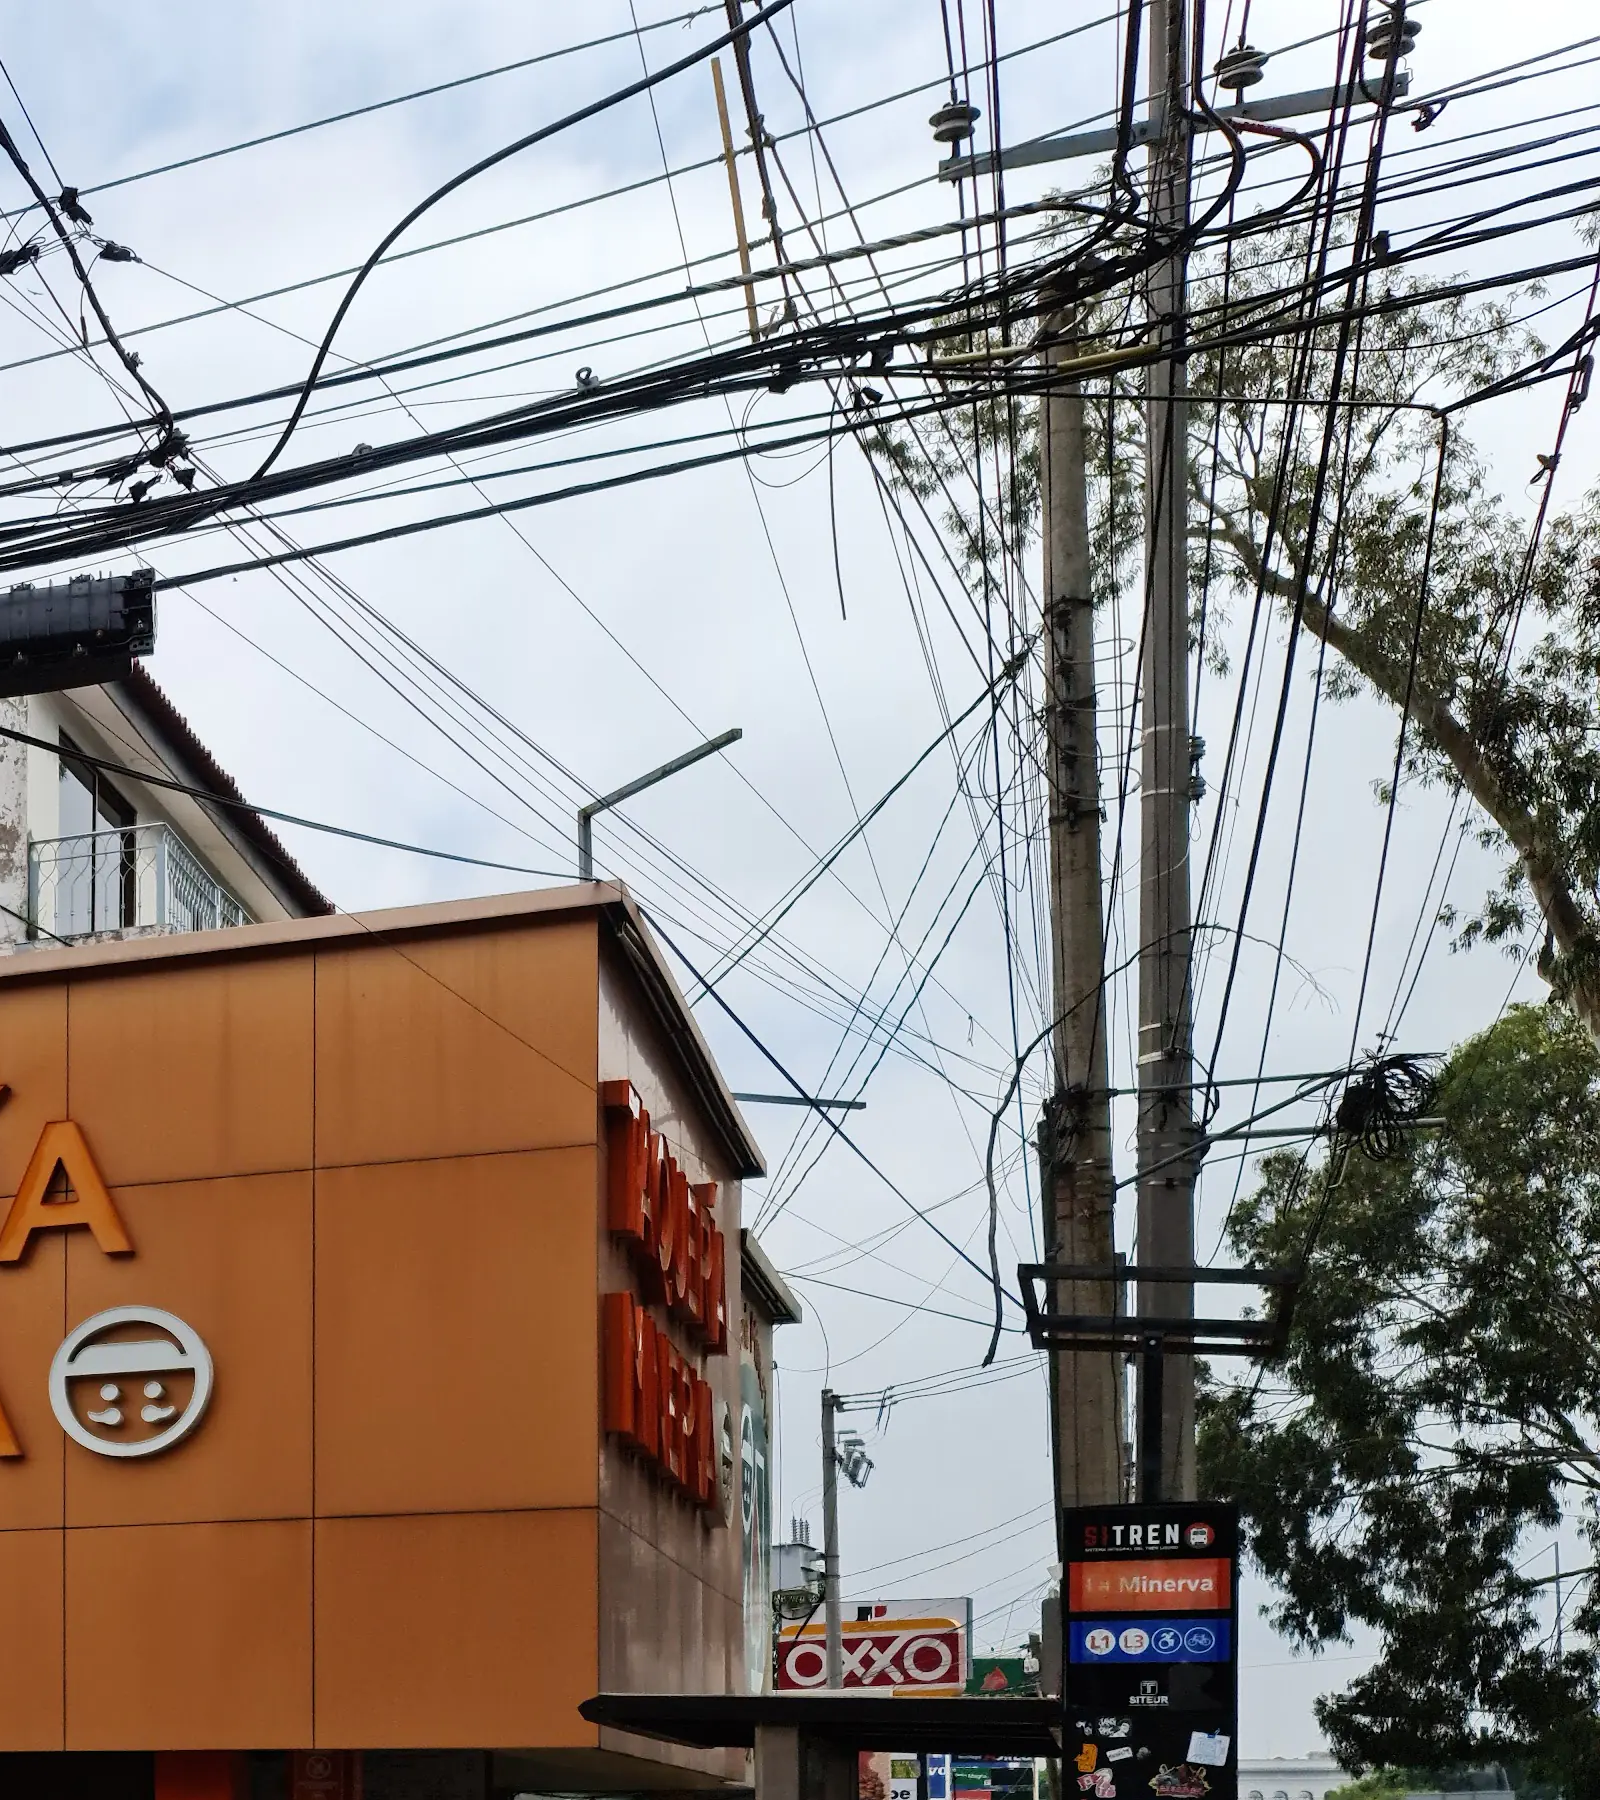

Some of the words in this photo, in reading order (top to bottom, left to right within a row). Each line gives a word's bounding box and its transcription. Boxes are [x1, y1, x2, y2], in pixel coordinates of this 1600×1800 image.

[1084, 1523, 1180, 1546] SITREN
[1119, 1575, 1213, 1593] Minerva
[1090, 1635, 1110, 1650] L1
[1124, 1634, 1144, 1648] L3
[785, 1636, 953, 1687] OXXO
[1128, 1696, 1169, 1704] SITEUR
